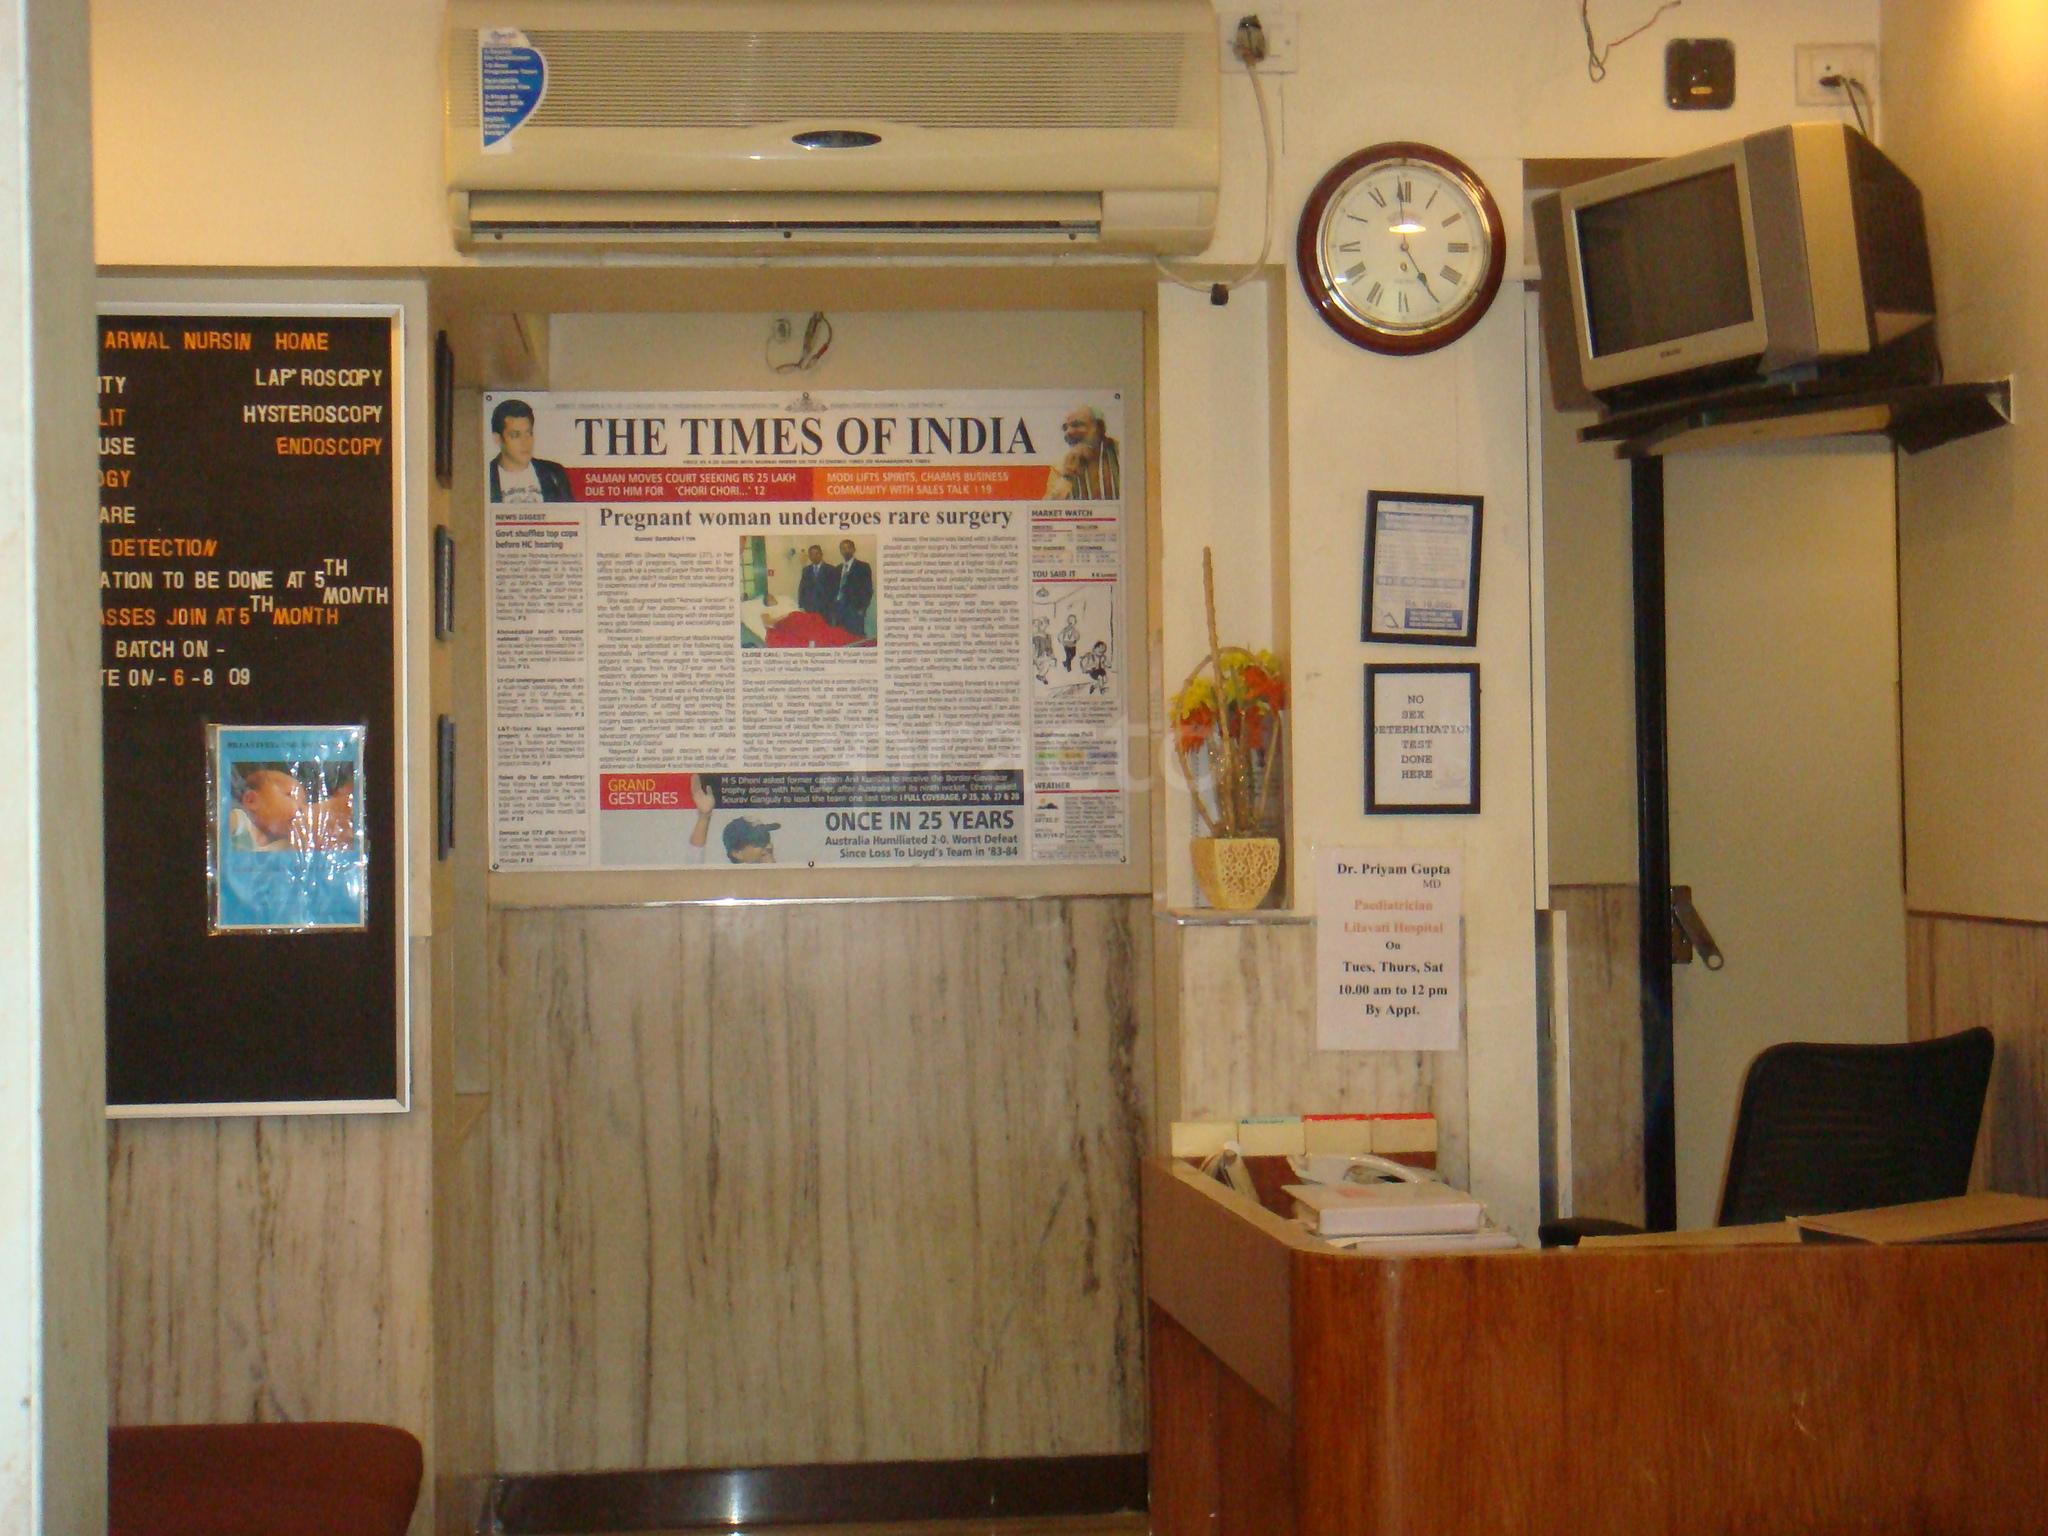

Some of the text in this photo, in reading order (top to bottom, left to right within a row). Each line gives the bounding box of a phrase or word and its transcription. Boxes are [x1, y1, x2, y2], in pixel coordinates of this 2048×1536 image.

[275, 332, 329, 350] HOME
[243, 405, 383, 424] HYSTEROSCOPY
[575, 416, 1037, 456] THE TIMES OF INDIA
[275, 436, 383, 456] ENDOSCOPY
[585, 472, 797, 484] SALMAN MOVES COURT SEEKING RS 25 LAKH
[826, 471, 854, 482] MODI
[856, 471, 880, 482] LIFTS
[920, 471, 961, 482] CHARMS
[963, 471, 1009, 482] BUSINESS
[585, 486, 605, 496] DUE
[608, 486, 621, 496] TO
[623, 486, 643, 496] HIM
[645, 486, 664, 496] FOR
[754, 486, 766, 496] 12
[826, 485, 887, 495] COMMUNITY
[890, 485, 914, 495] WITH
[916, 485, 944, 495] SALES
[947, 485, 969, 495] TALK
[99, 506, 136, 524] ARE
[495, 513, 517, 521] NEWS
[600, 507, 1013, 531] Pregnant woman undergoes rare surgery
[1031, 509, 1093, 517] MARKET WATCH
[110, 538, 218, 557] DETECTION
[100, 571, 153, 589] ATION
[162, 571, 184, 589] TO
[195, 571, 220, 589] BE
[229, 570, 274, 591] DONE
[286, 571, 305, 589] AT
[323, 586, 389, 605] MONTH
[166, 608, 207, 626] JOIN
[216, 608, 235, 626] AT
[273, 606, 340, 626] MONTH
[115, 640, 175, 658] BATCH
[183, 640, 208, 658] ON
[1407, 694, 1425, 704] NO
[1401, 710, 1425, 720] SEX
[1401, 740, 1433, 749] TEST
[1400, 755, 1433, 764] DONE
[1401, 770, 1433, 779] HERE
[608, 778, 656, 792] GRAND
[608, 792, 679, 805] GESTURES
[825, 811, 883, 832] ONCE
[889, 811, 911, 831] IN
[918, 810, 943, 830] 25
[950, 810, 1015, 830] YEARS
[825, 836, 870, 846] Australia
[873, 835, 928, 845] Humiliated
[952, 834, 981, 844] Worst
[984, 833, 1018, 844] Defeat
[839, 848, 867, 859] Since
[869, 848, 891, 858] Loss
[894, 848, 905, 858] To
[946, 847, 972, 857] Team
[975, 847, 985, 857] in
[1337, 863, 1451, 878] Dr. Priyam Gupta
[1423, 879, 1442, 889] MD
[1354, 900, 1433, 911] Paediatrician
[1343, 922, 1443, 935] Lilavati Hospital
[1385, 941, 1401, 950] On
[1423, 961, 1444, 973] Sat
[1338, 984, 1448, 998] 10.00 am to 12 pm
[1365, 1004, 1420, 1018] By Appt.
